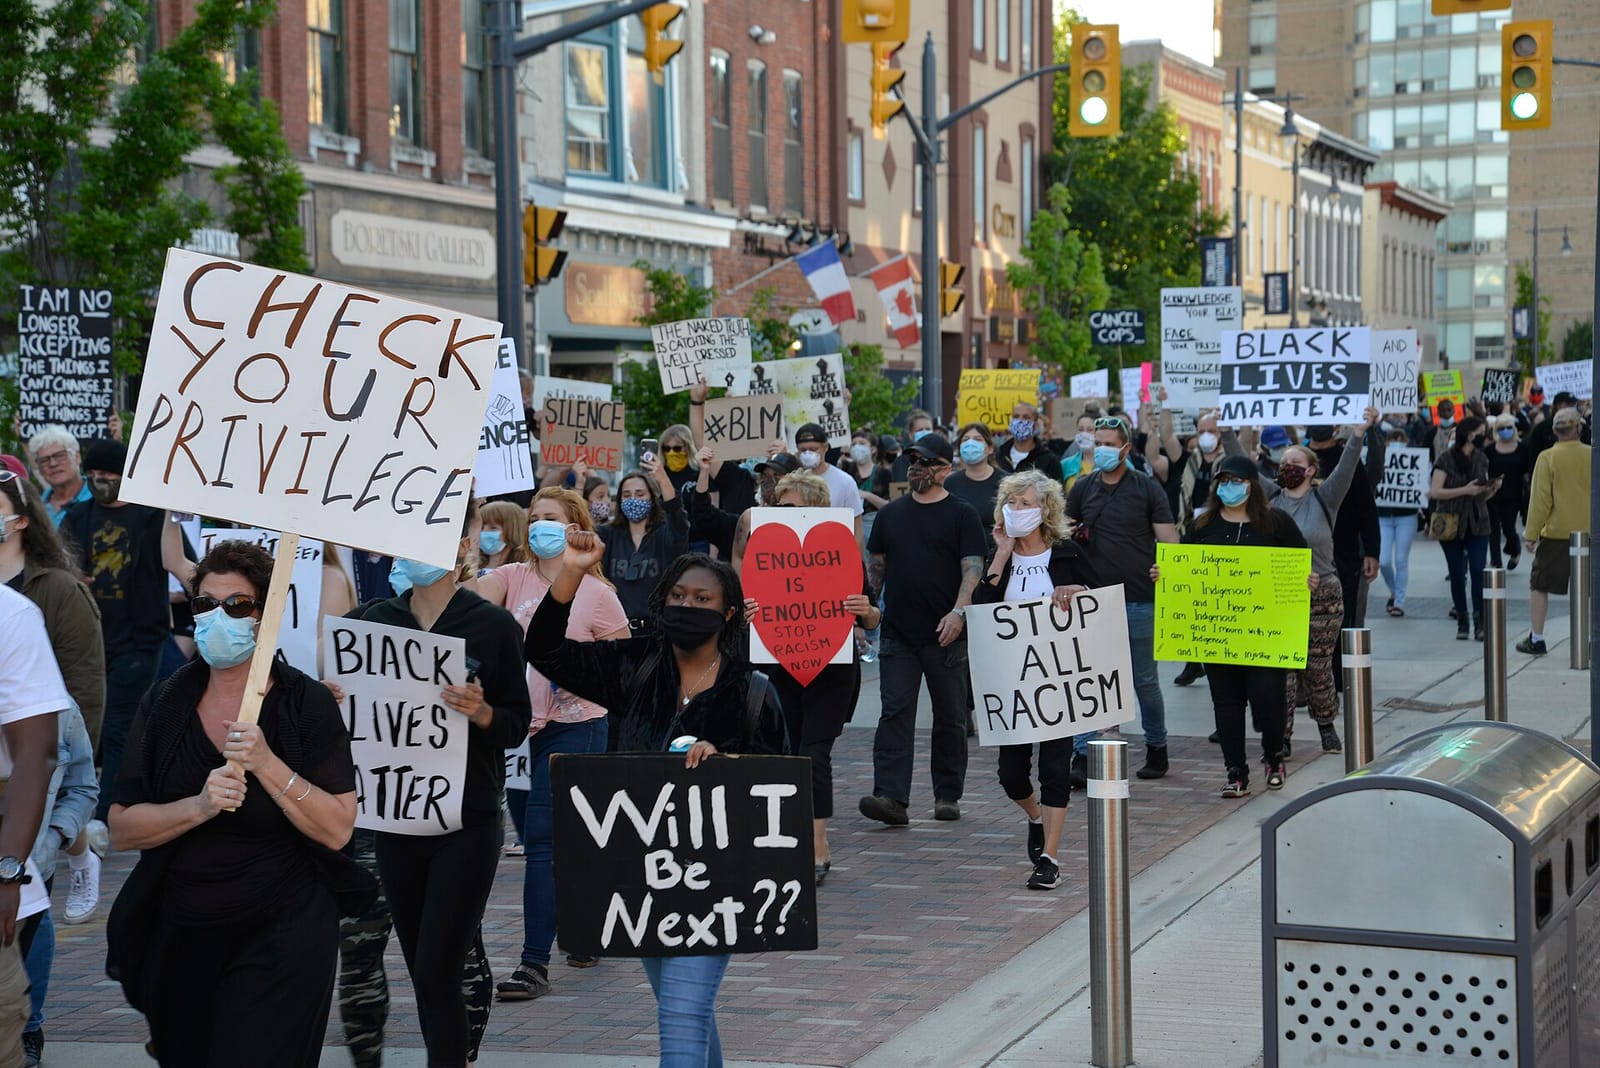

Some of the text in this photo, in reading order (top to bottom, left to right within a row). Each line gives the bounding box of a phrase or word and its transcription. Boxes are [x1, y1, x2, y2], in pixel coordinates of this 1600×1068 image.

[423, 229, 486, 267] GALLERY
[20, 284, 112, 312] I AM NO
[1163, 292, 1232, 304] ACKNOWLEDGE
[1089, 310, 1144, 328] CANCEL
[1186, 307, 1208, 318] YOUR
[18, 312, 80, 335] LONGER
[184, 261, 495, 390] CHECK
[654, 318, 750, 341] THE NAKED TRUTH
[1165, 328, 1194, 339] FACE
[20, 334, 111, 358] ACCEPTING
[656, 342, 667, 353] IS
[720, 334, 737, 346] THE
[1235, 330, 1351, 359] BLACK
[1382, 338, 1407, 353] AND
[20, 357, 45, 374] THE
[49, 357, 95, 375] THINGS
[97, 360, 109, 373] I
[661, 351, 694, 368] WELL
[695, 347, 737, 362] DRESSED
[103, 379, 112, 393] I
[170, 324, 438, 449] YOUR
[961, 374, 990, 385] STOP
[1232, 363, 1348, 391] LIVES
[20, 391, 111, 408] AM CHANGING
[1371, 387, 1416, 409] MATTER
[20, 404, 107, 422] THE THINGS I
[544, 397, 623, 432] SILENCE
[704, 403, 781, 443] #BLM
[574, 430, 588, 444] IS
[127, 393, 471, 524] PRIVILEGE
[540, 444, 619, 469] VIOLENCE
[756, 550, 842, 571] ENOUGH
[1160, 548, 1165, 561] I
[1191, 566, 1209, 576] and
[1249, 569, 1261, 578] you
[786, 577, 805, 593] IS
[1161, 577, 1253, 598] I am Indigenous
[762, 601, 846, 622] ENOUGH
[1160, 607, 1165, 619] I
[1172, 612, 1187, 620] am
[1192, 598, 1265, 614] and I hear you
[993, 594, 1099, 640] STOP
[774, 624, 817, 639] STOP
[1160, 628, 1164, 639] I
[1170, 632, 1185, 640] am
[1190, 623, 1206, 632] and
[1248, 627, 1265, 637] with
[1267, 629, 1282, 638] you
[332, 628, 454, 686] BLACK
[773, 637, 831, 657] RACISM
[1176, 647, 1191, 656] and
[1194, 647, 1199, 657] I
[1203, 649, 1217, 657] see
[1224, 647, 1239, 659] the
[790, 658, 821, 671] NOW
[1020, 637, 1092, 681] ALL
[984, 669, 1122, 731] RACISM
[349, 694, 450, 749] LIVES
[354, 764, 449, 830] ATTER
[569, 782, 799, 850] Will I
[644, 848, 711, 890] Be
